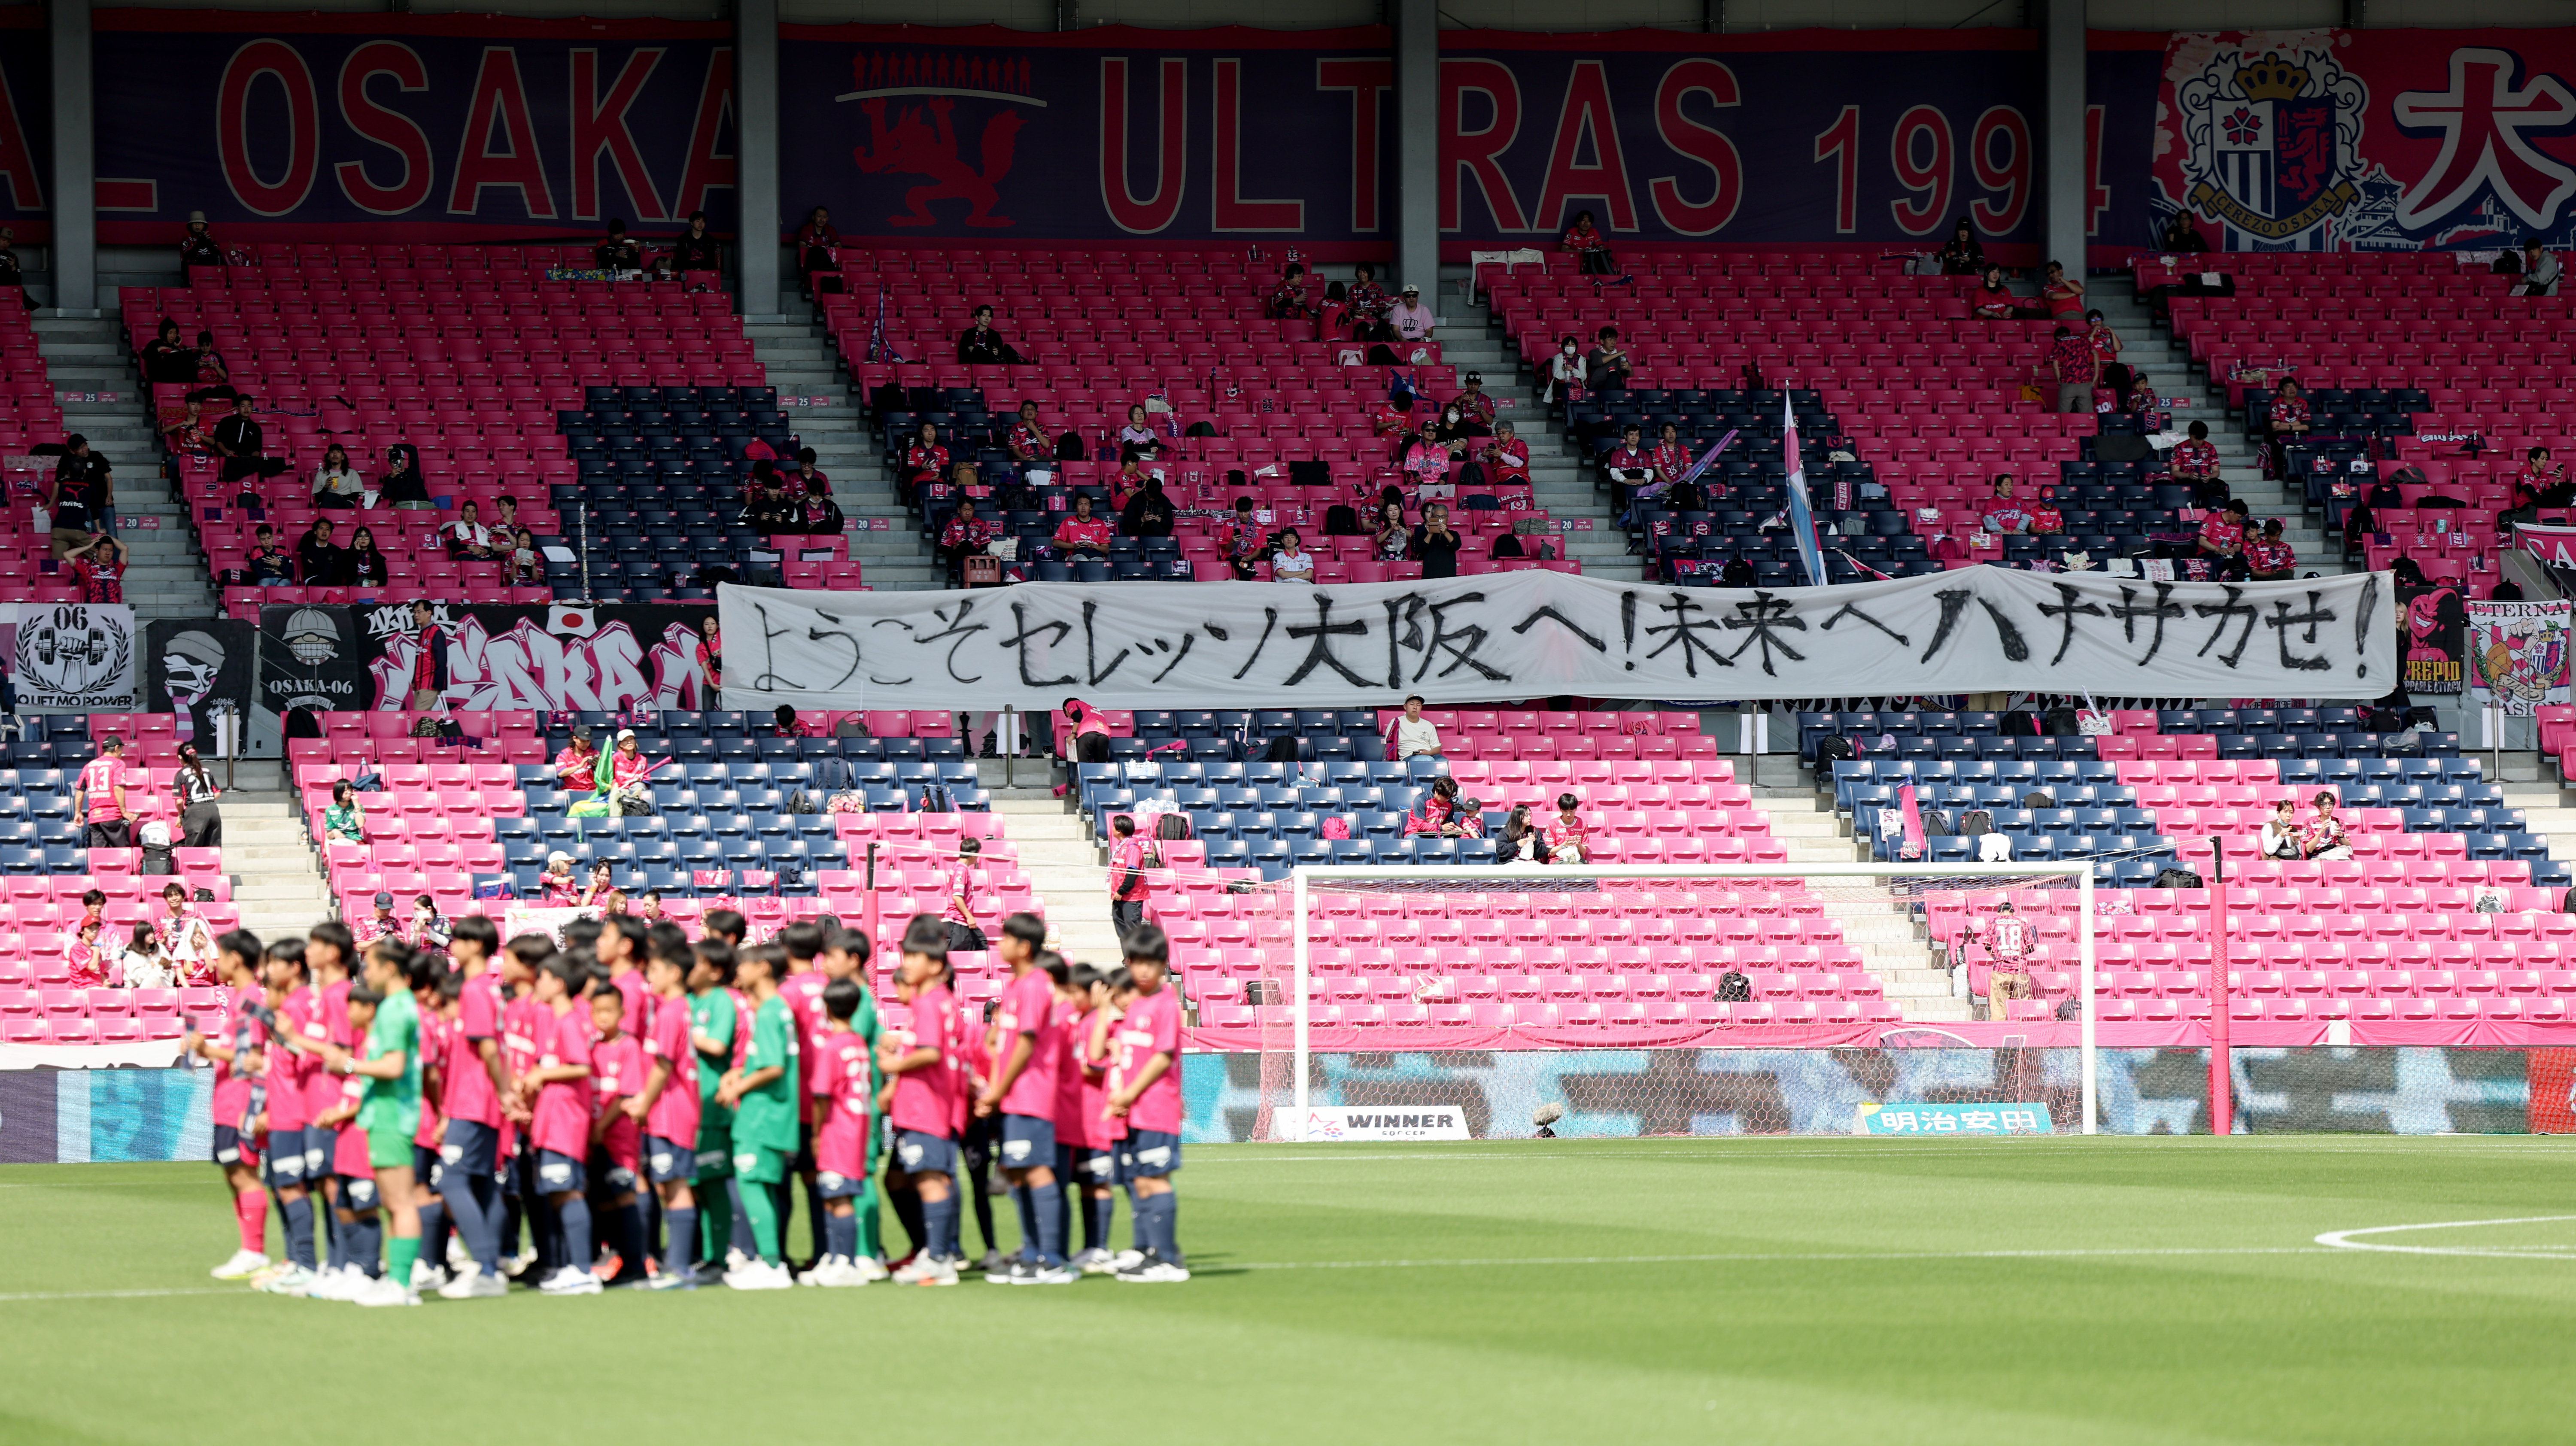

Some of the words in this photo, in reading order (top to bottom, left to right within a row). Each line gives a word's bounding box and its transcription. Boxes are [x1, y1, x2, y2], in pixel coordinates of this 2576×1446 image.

[216, 38, 782, 223] OSAKA
[1100, 57, 1743, 236] ULTRAS
[2395, 47, 2576, 231] 大
[2216, 195, 2272, 233] CEREZO
[2278, 195, 2334, 234] OSAKA
[2161, 398, 2170, 407] 25
[1668, 466, 1678, 476] 38
[1838, 482, 1847, 510] CEREZO
[1563, 521, 1572, 529] 20
[2473, 601, 2567, 617] ETERNA
[54, 607, 88, 630] 06
[270, 680, 353, 694] OSAKA-06
[2434, 680, 2461, 693] ATTACK
[30, 696, 55, 707] LIFT
[57, 695, 81, 707] MO
[83, 695, 133, 707] POWER
[87, 766, 110, 792] 13
[1997, 926, 2020, 951] 18
[1346, 1114, 1454, 1129] WINNER
[1880, 1112, 2037, 1132] 明治安田
